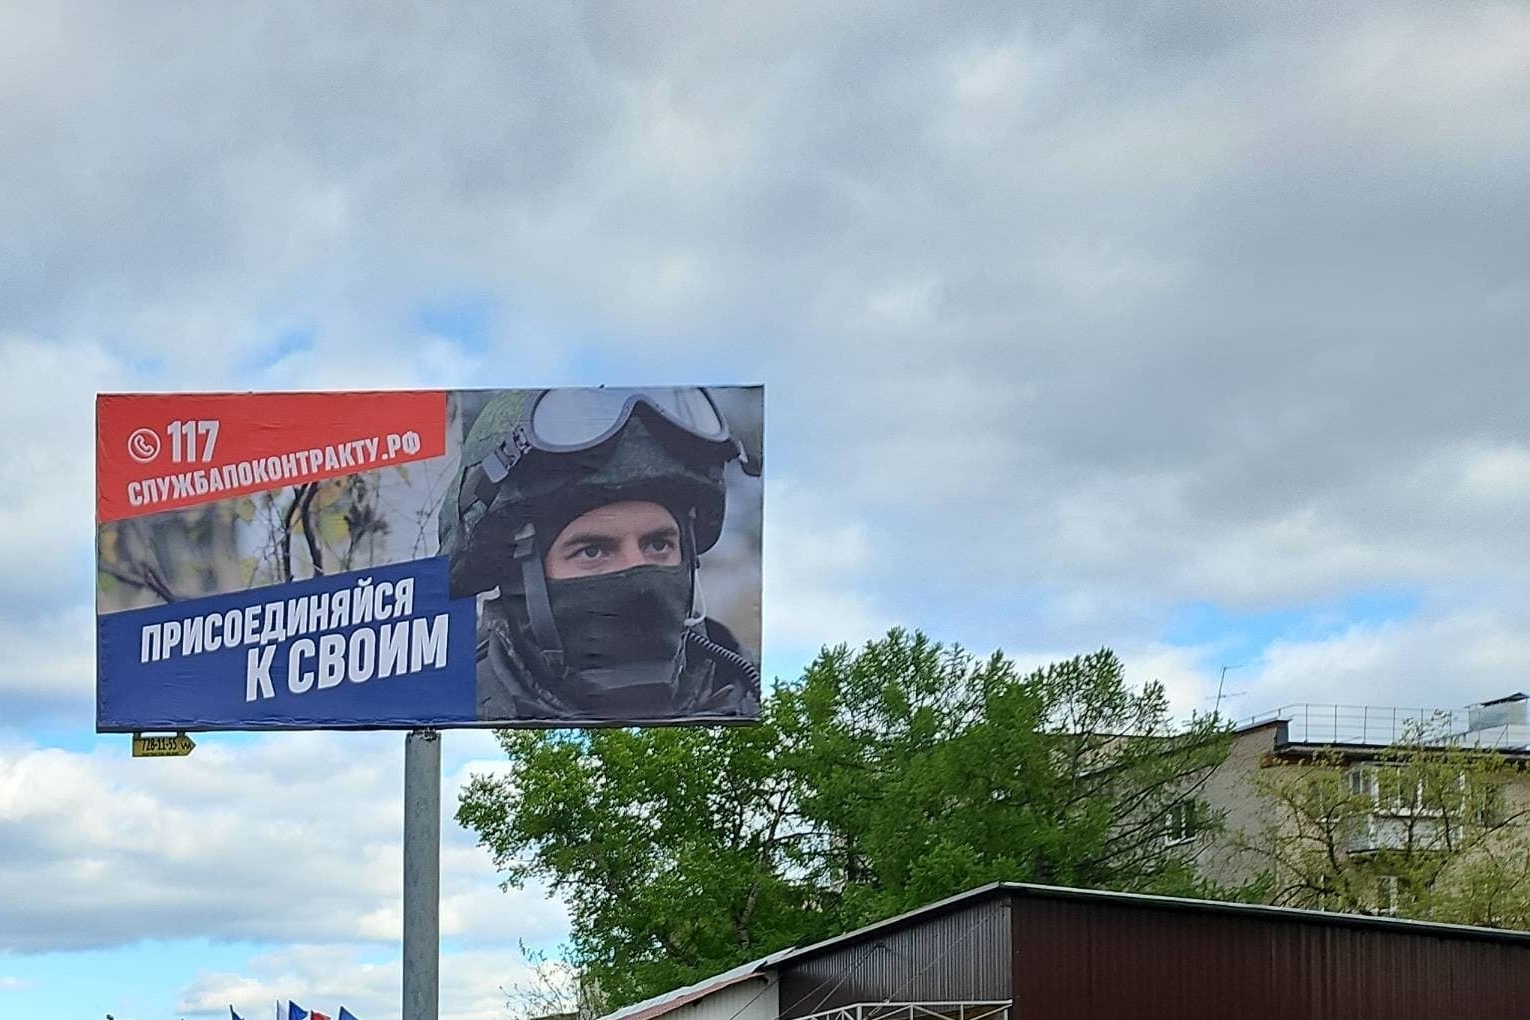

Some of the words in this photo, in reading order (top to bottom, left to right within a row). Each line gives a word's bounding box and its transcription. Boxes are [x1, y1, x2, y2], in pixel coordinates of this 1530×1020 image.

[127, 430, 421, 507] СЛУЖБАПОКОНТРАКТУ.РФ
[167, 420, 220, 463] 117
[141, 576, 415, 663] ПРИСОЕДИНЯЙСЯ
[245, 643, 277, 702] К
[288, 613, 449, 694] СВОИМ
